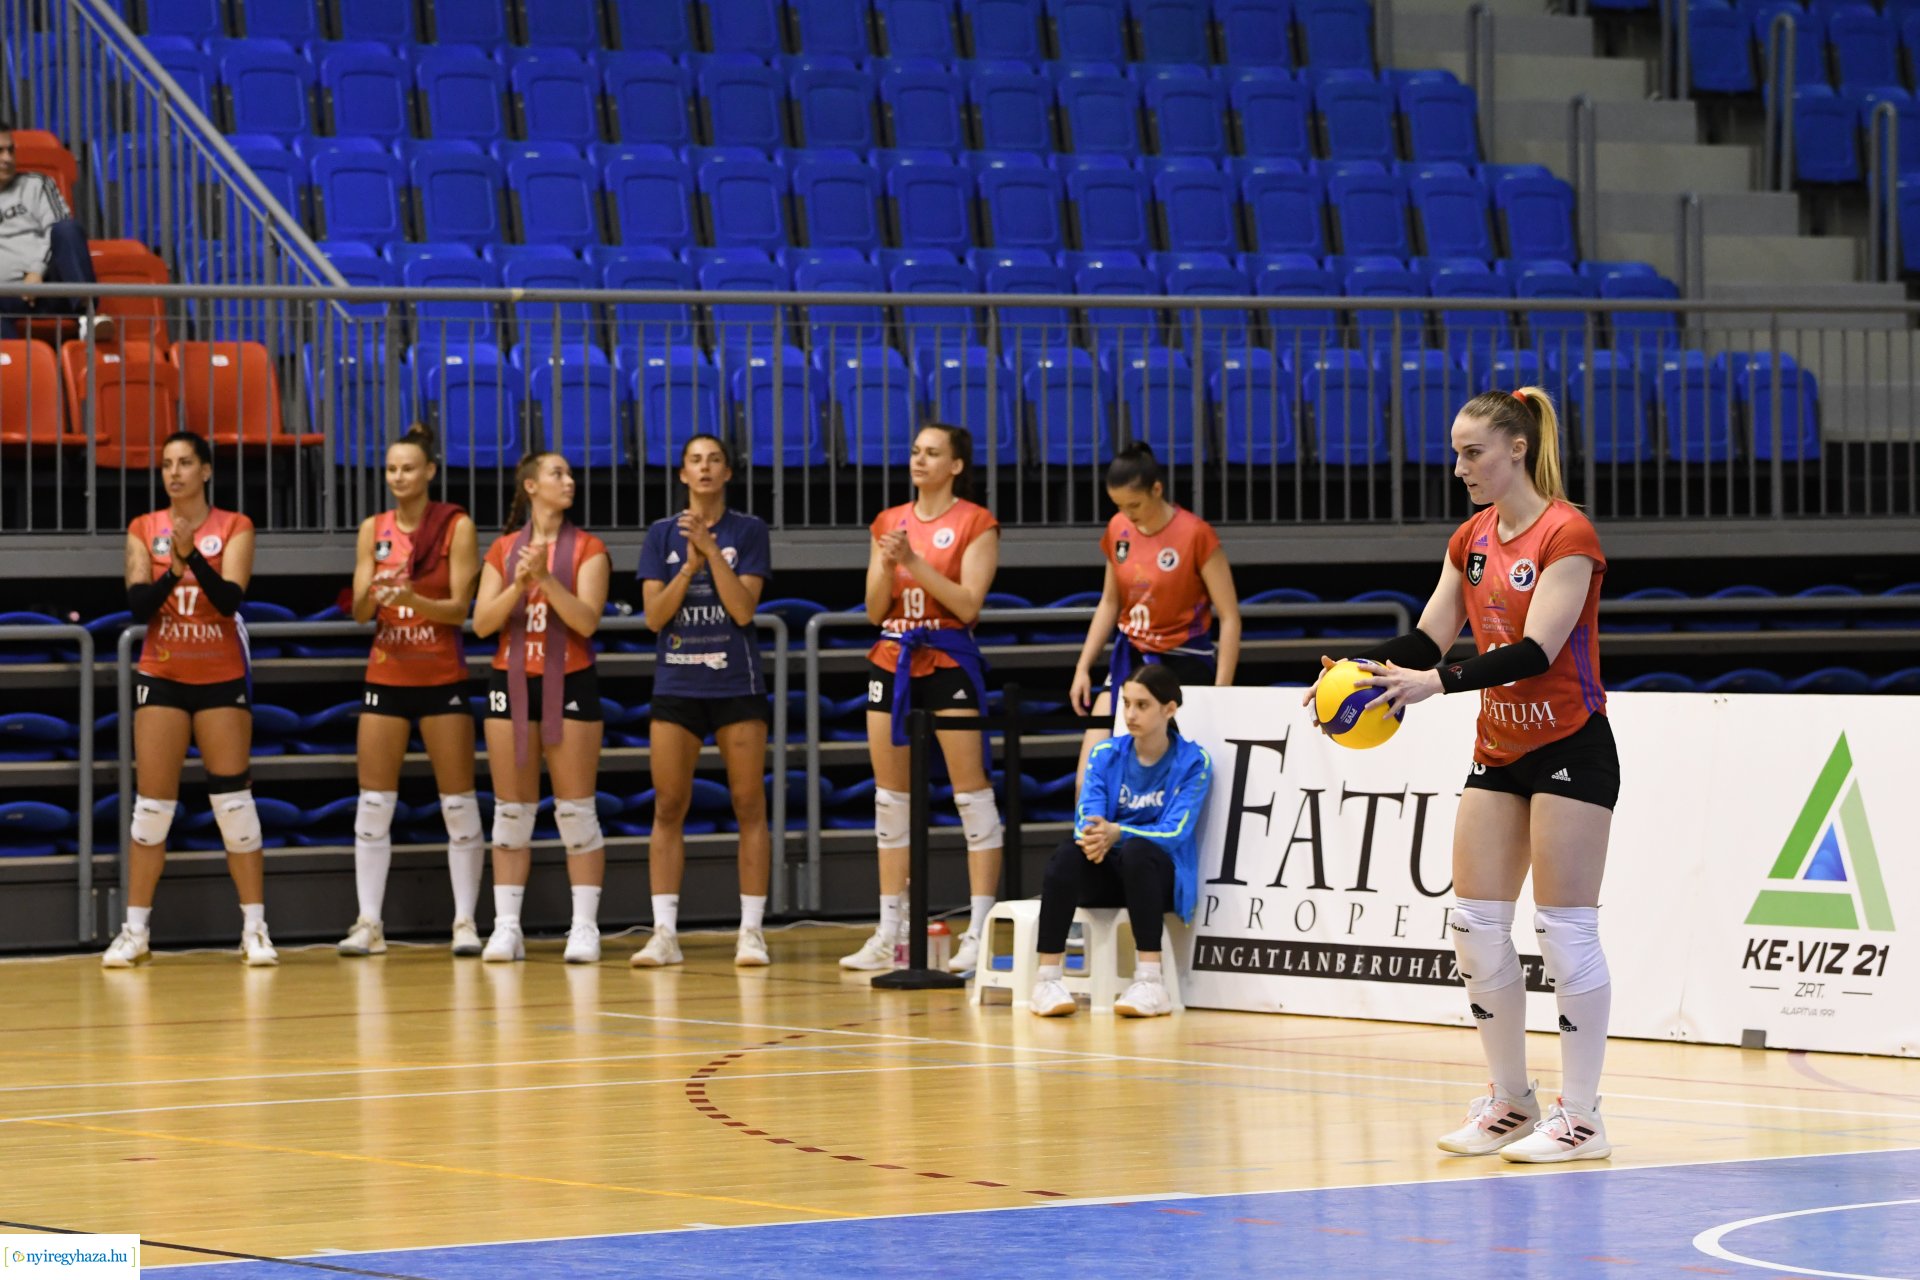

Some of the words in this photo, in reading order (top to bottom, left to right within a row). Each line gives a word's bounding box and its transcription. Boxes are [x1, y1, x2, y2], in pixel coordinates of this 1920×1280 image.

[174, 586, 199, 616] 17
[675, 605, 726, 621] ATUM
[902, 587, 925, 619] 19
[159, 616, 223, 639] FATUM
[526, 602, 547, 633] 13
[489, 690, 507, 712] 13
[868, 680, 884, 704] 19
[1482, 686, 1557, 724] FATUM
[1205, 724, 1463, 898] FATU
[1198, 944, 1461, 982] INGATLANBERUHÁZ
[1741, 938, 1850, 975] KE-VIZ
[1852, 944, 1890, 977] 21
[1794, 982, 1825, 999] ZRT.
